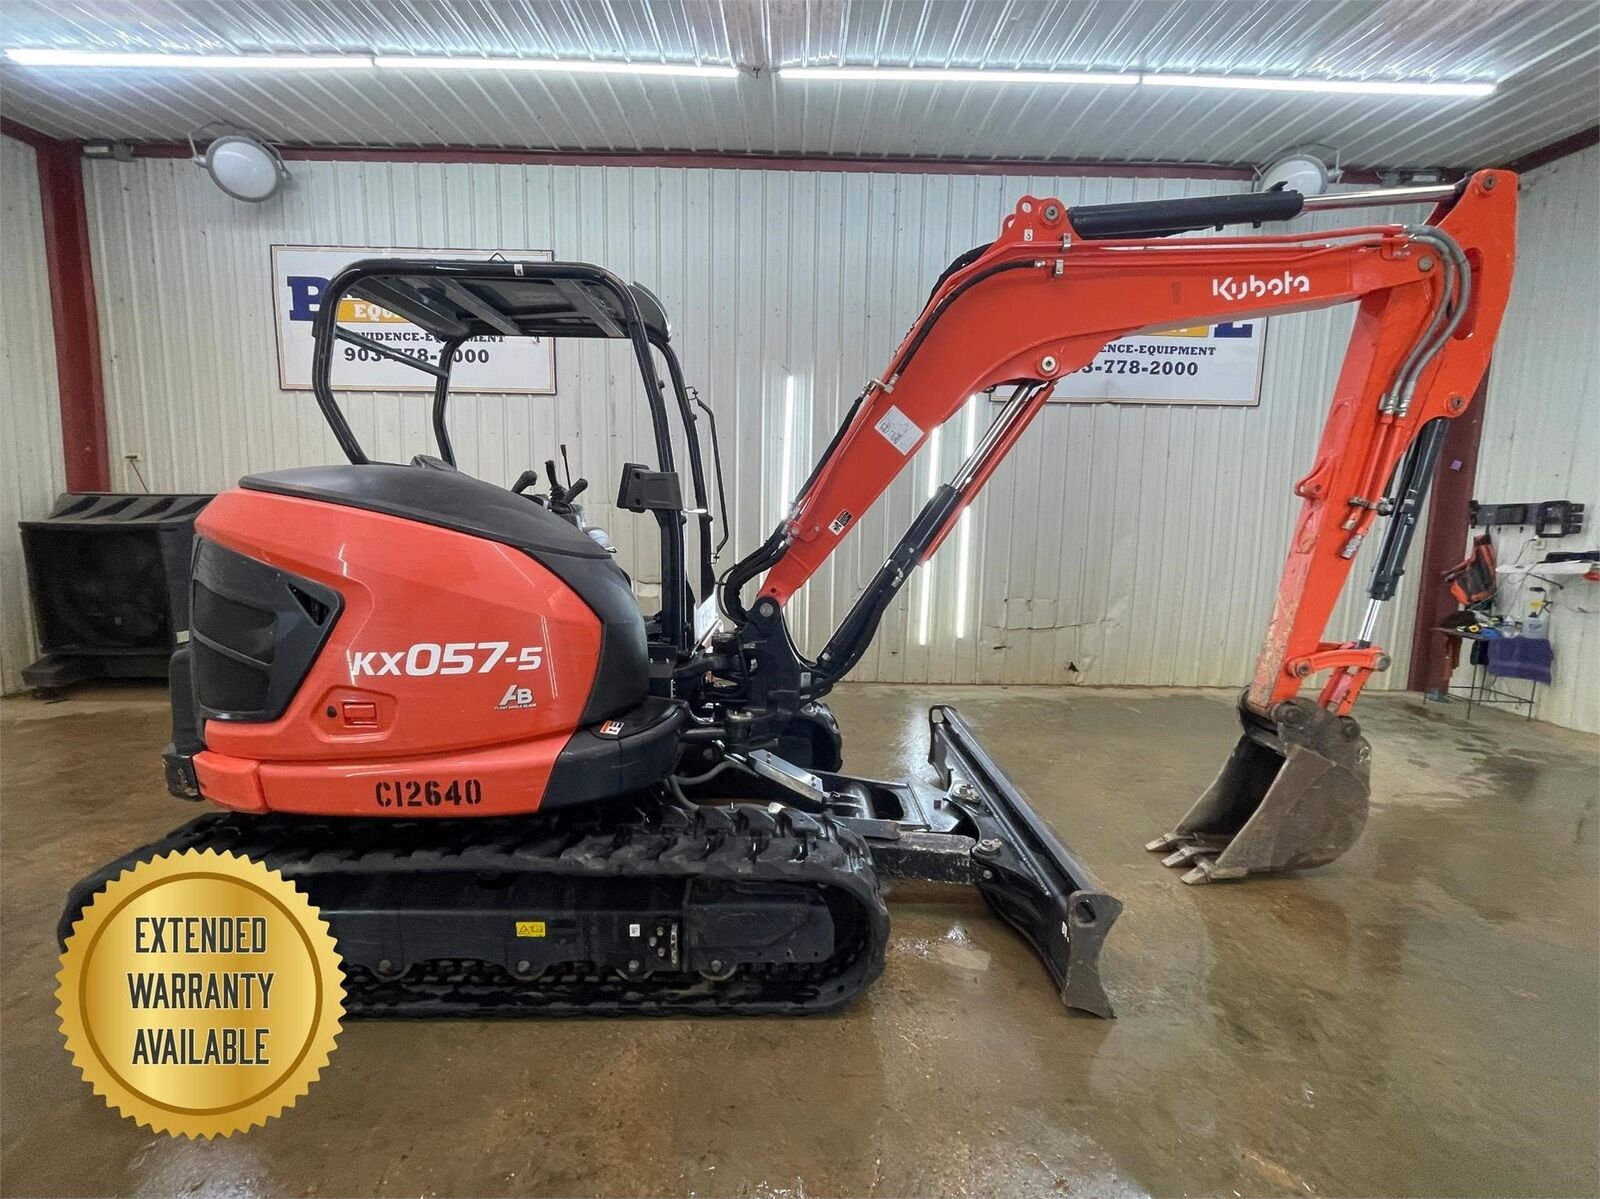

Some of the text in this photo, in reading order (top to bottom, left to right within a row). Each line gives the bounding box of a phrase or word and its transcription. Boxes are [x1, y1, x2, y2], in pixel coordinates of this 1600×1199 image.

[1212, 270, 1310, 300] Kubota
[1100, 344, 1217, 356] ENCE-EQUIPMENT
[1073, 359, 1199, 377] 3-778-2000
[352, 641, 543, 677] KX057-5
